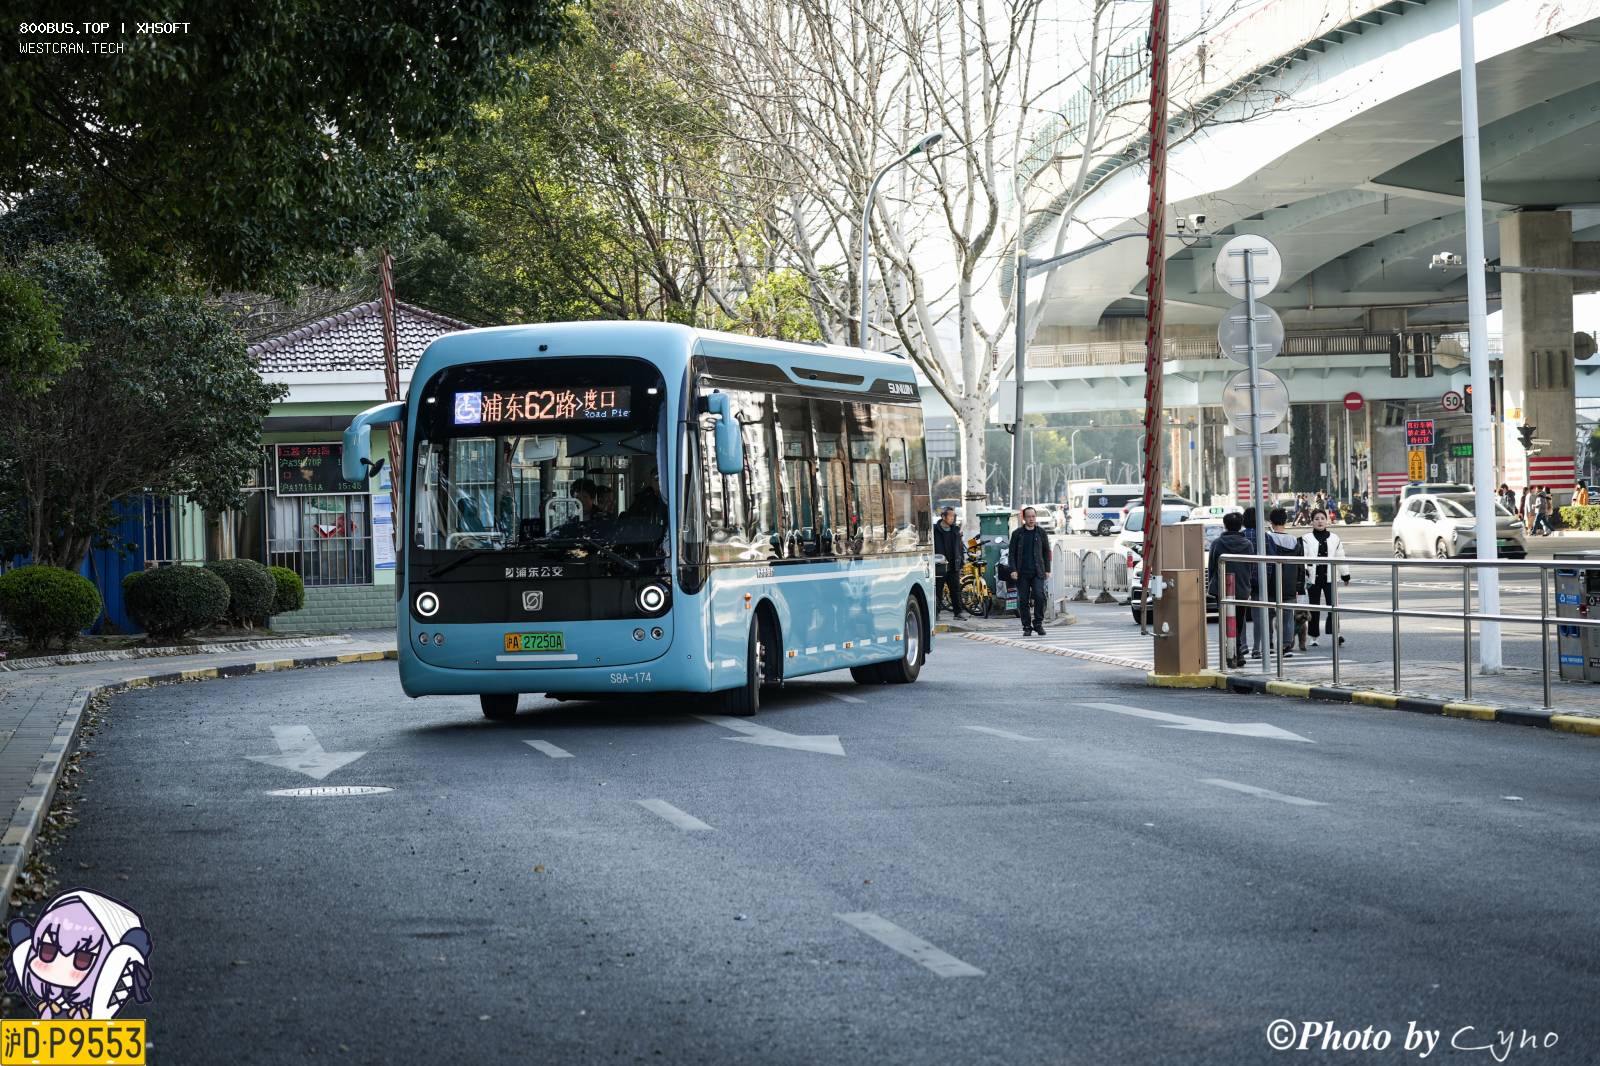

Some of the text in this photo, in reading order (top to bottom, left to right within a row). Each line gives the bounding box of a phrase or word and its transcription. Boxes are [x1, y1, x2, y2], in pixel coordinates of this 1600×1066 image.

[888, 382, 913, 395] SUNWIN
[482, 390, 577, 422] 浦东62路
[1446, 396, 1458, 406] 50
[515, 566, 564, 578] 浦东公交
